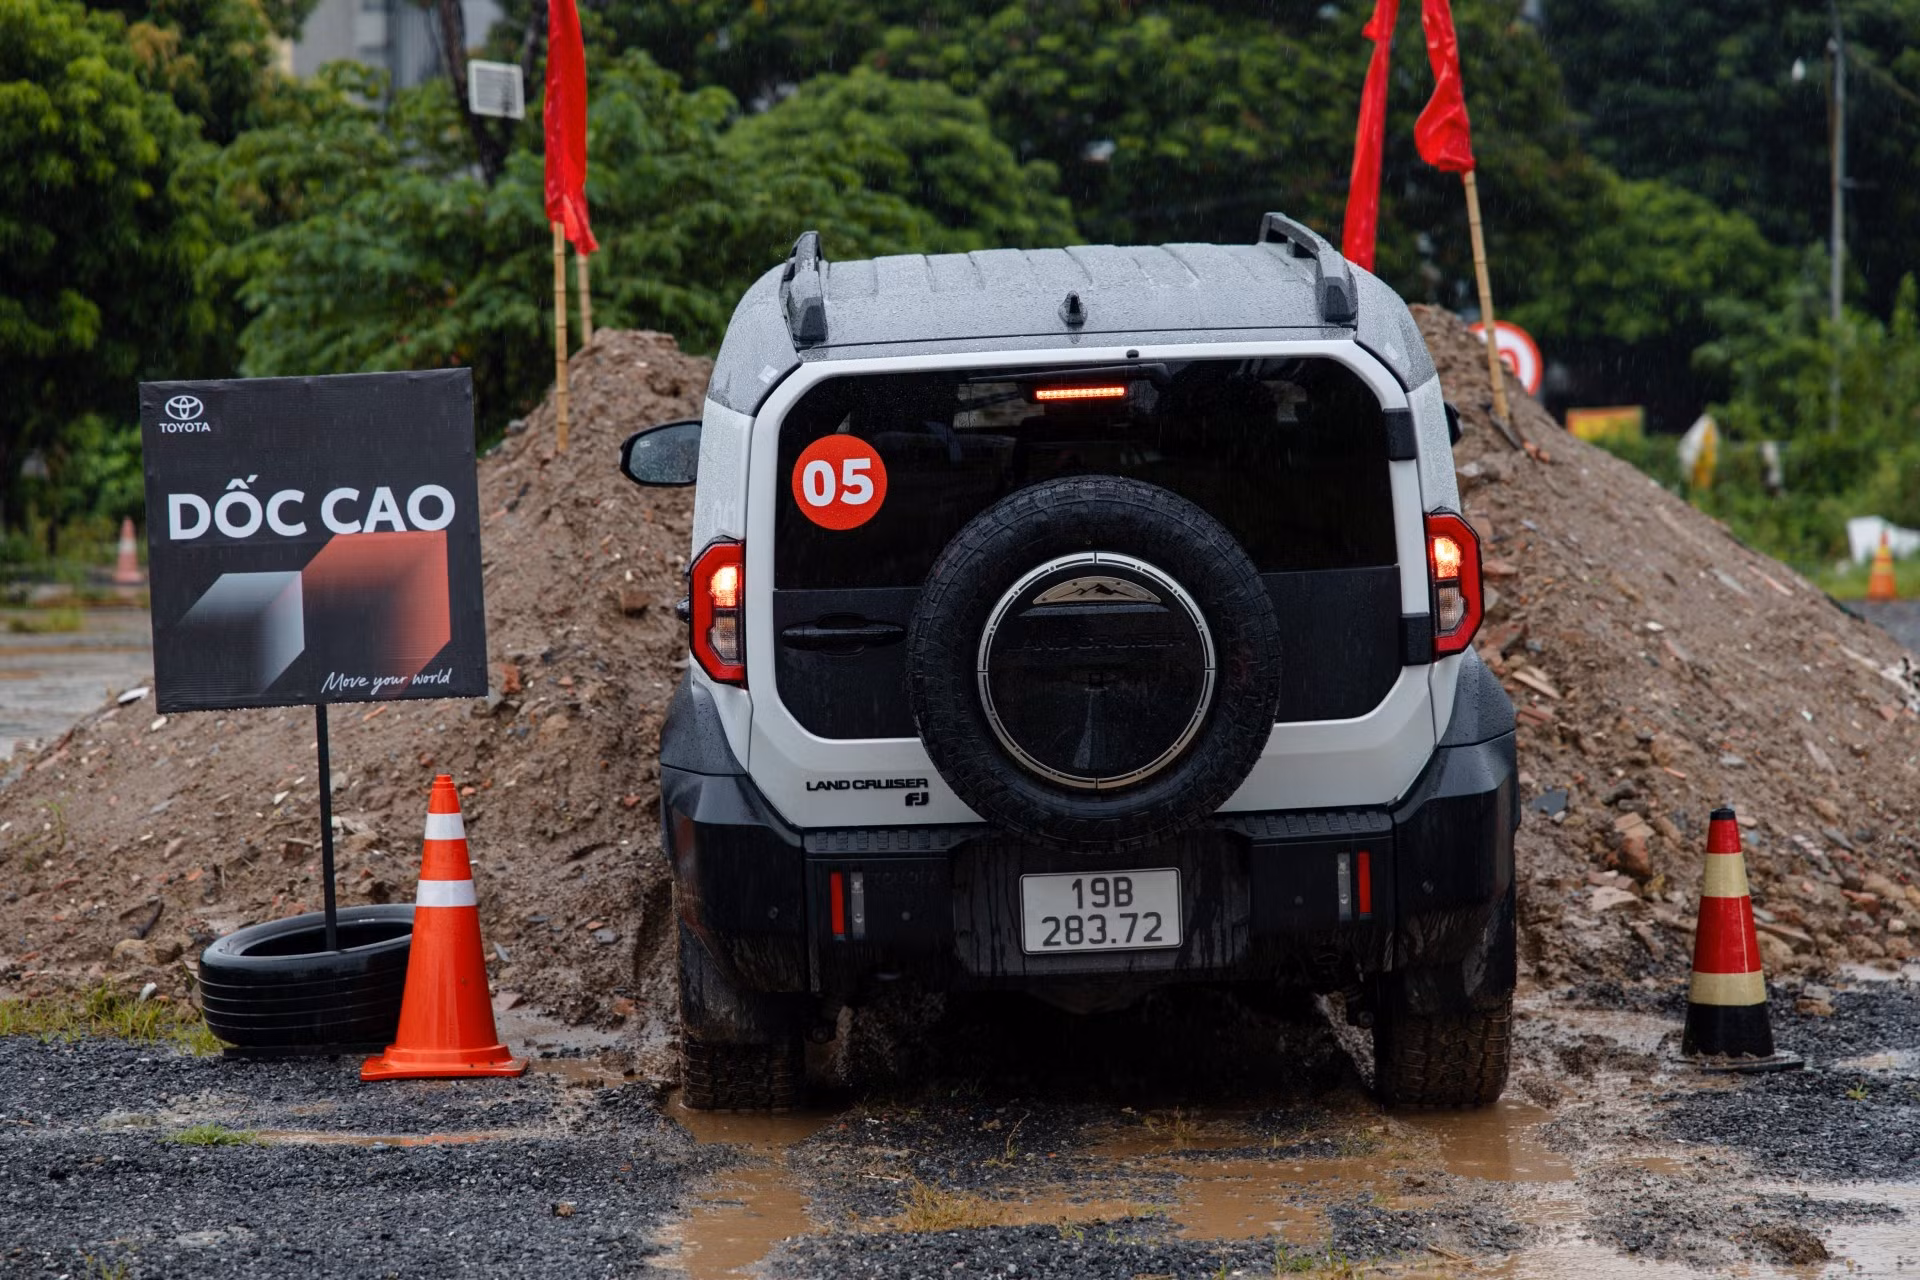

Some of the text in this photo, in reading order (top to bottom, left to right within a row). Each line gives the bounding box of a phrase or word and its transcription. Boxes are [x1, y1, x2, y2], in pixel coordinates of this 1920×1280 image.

[159, 421, 211, 434] TOYOTA
[802, 457, 874, 507] 05
[168, 474, 456, 540] DỐC CAO
[320, 667, 453, 696] Move your world
[806, 778, 928, 791] LAND CRUISER
[905, 791, 929, 806] FJ
[1071, 876, 1134, 909] 19B
[1041, 912, 1163, 947] 283.72
